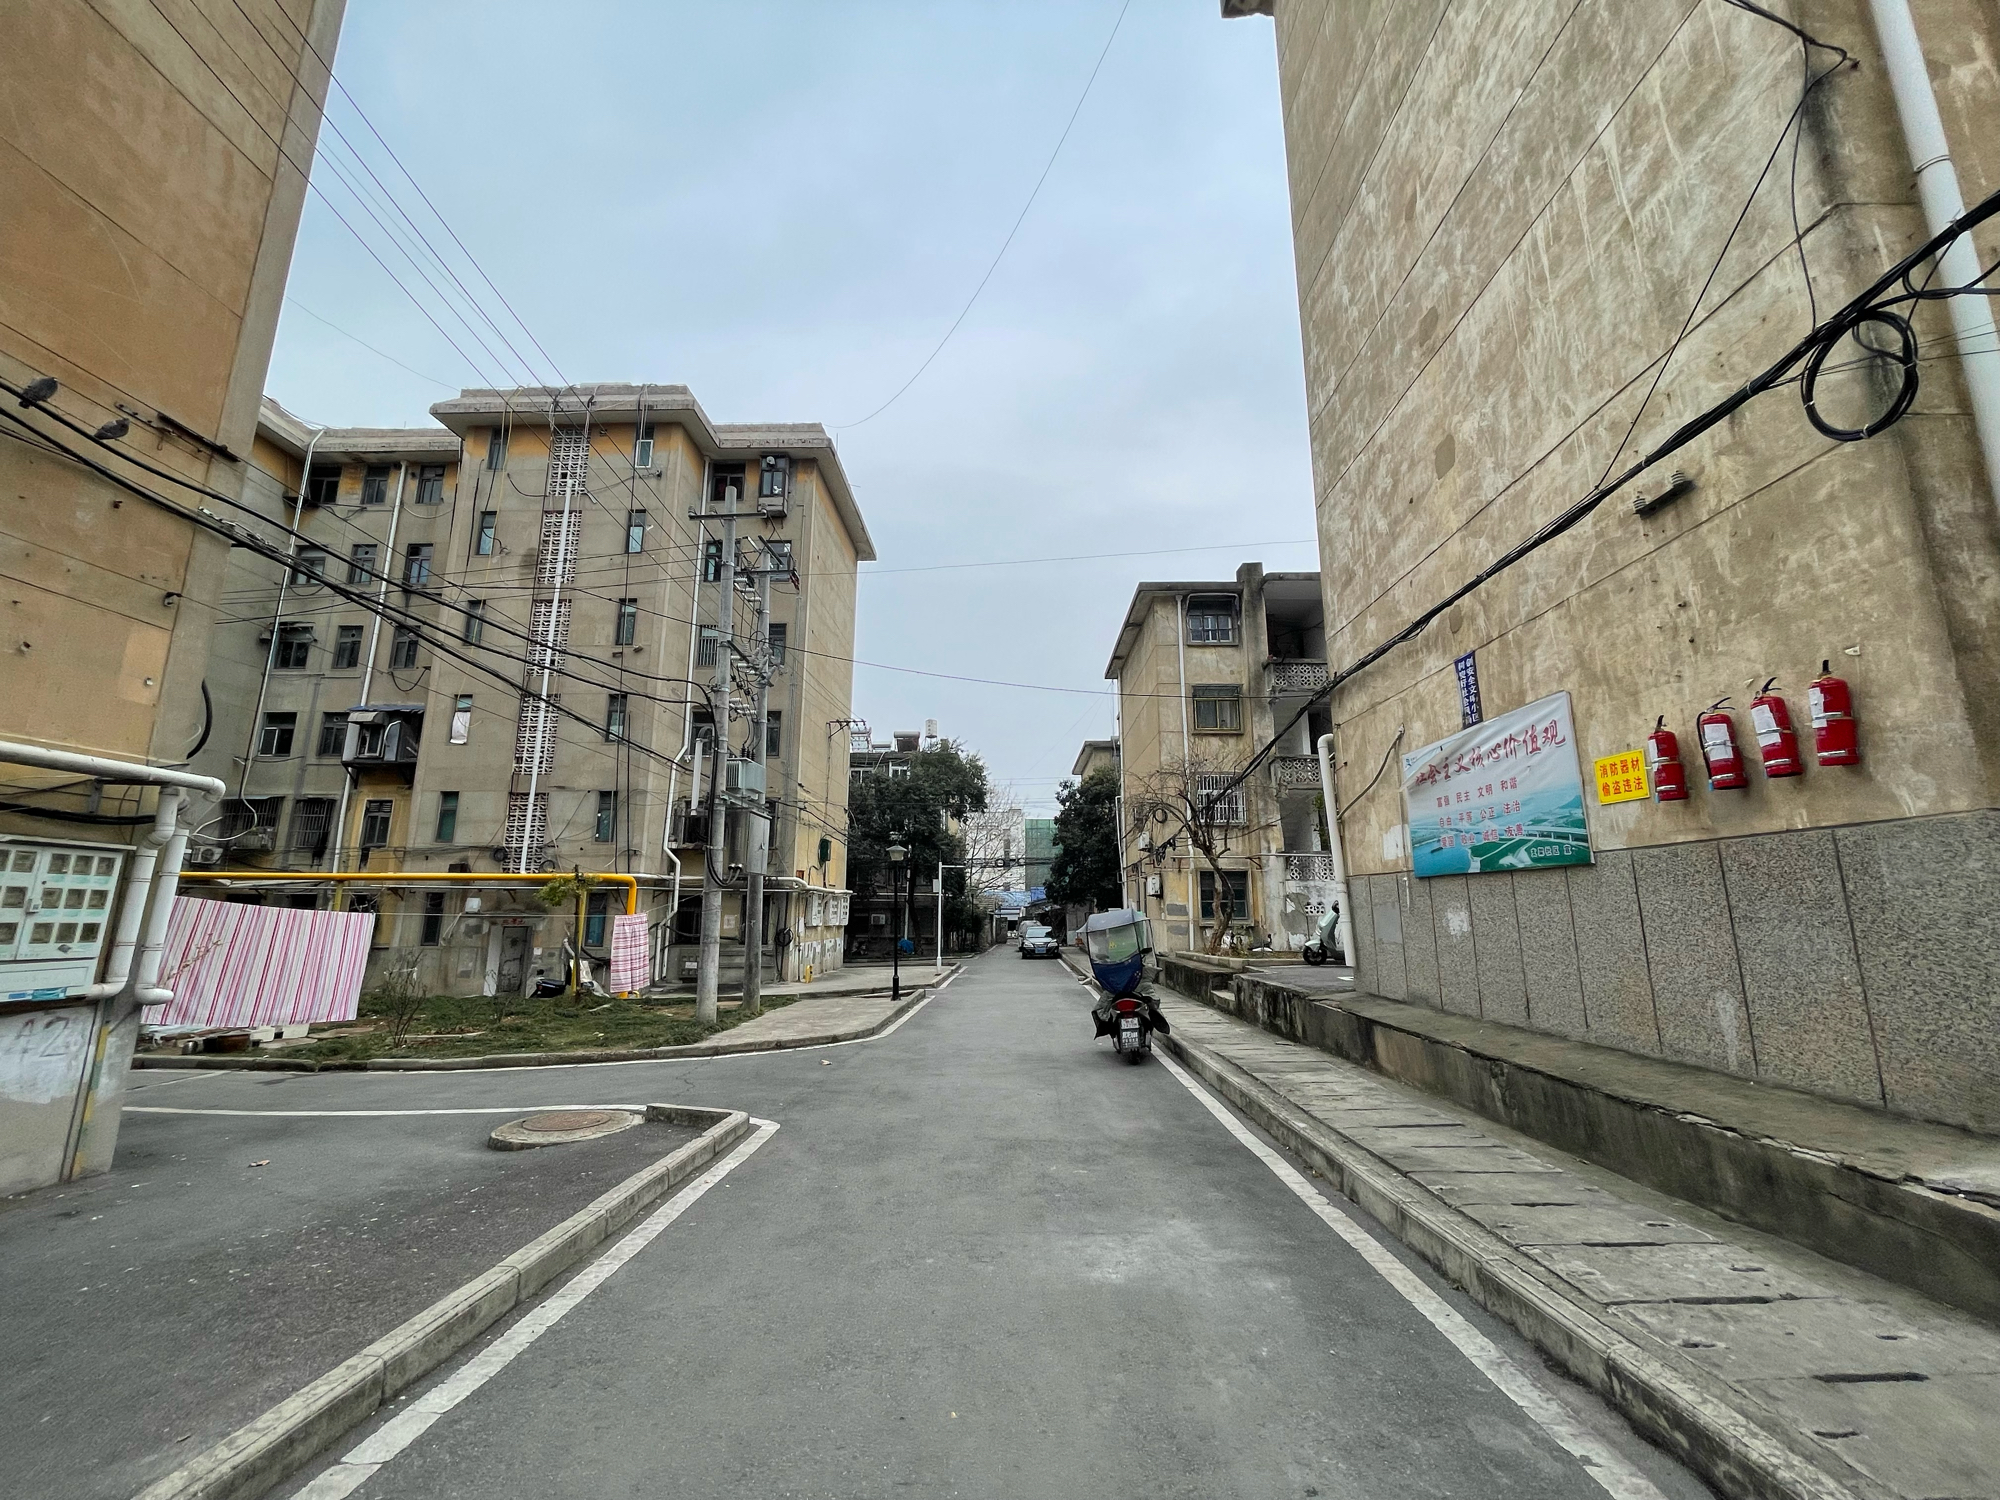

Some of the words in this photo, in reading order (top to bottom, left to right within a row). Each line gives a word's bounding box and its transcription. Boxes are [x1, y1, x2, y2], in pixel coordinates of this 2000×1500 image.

[1415, 719, 1566, 785] 社会主义核心价值观
[1600, 756, 1640, 778] 消防器材
[1436, 795, 1450, 808] 富强
[1456, 790, 1470, 803] 民主
[1477, 784, 1493, 798] 文明
[1500, 776, 1517, 792] 和谐
[1602, 775, 1643, 797] 偷盗违法
[1439, 816, 1452, 827] 自由
[1458, 811, 1472, 823] 平等
[1480, 806, 1496, 819] 公正
[1503, 800, 1520, 814] 法治
[1441, 835, 1455, 848] 爱国
[1460, 832, 1475, 845] 敬业
[1482, 829, 1498, 842] 诚信
[1505, 823, 1523, 837] 友善
